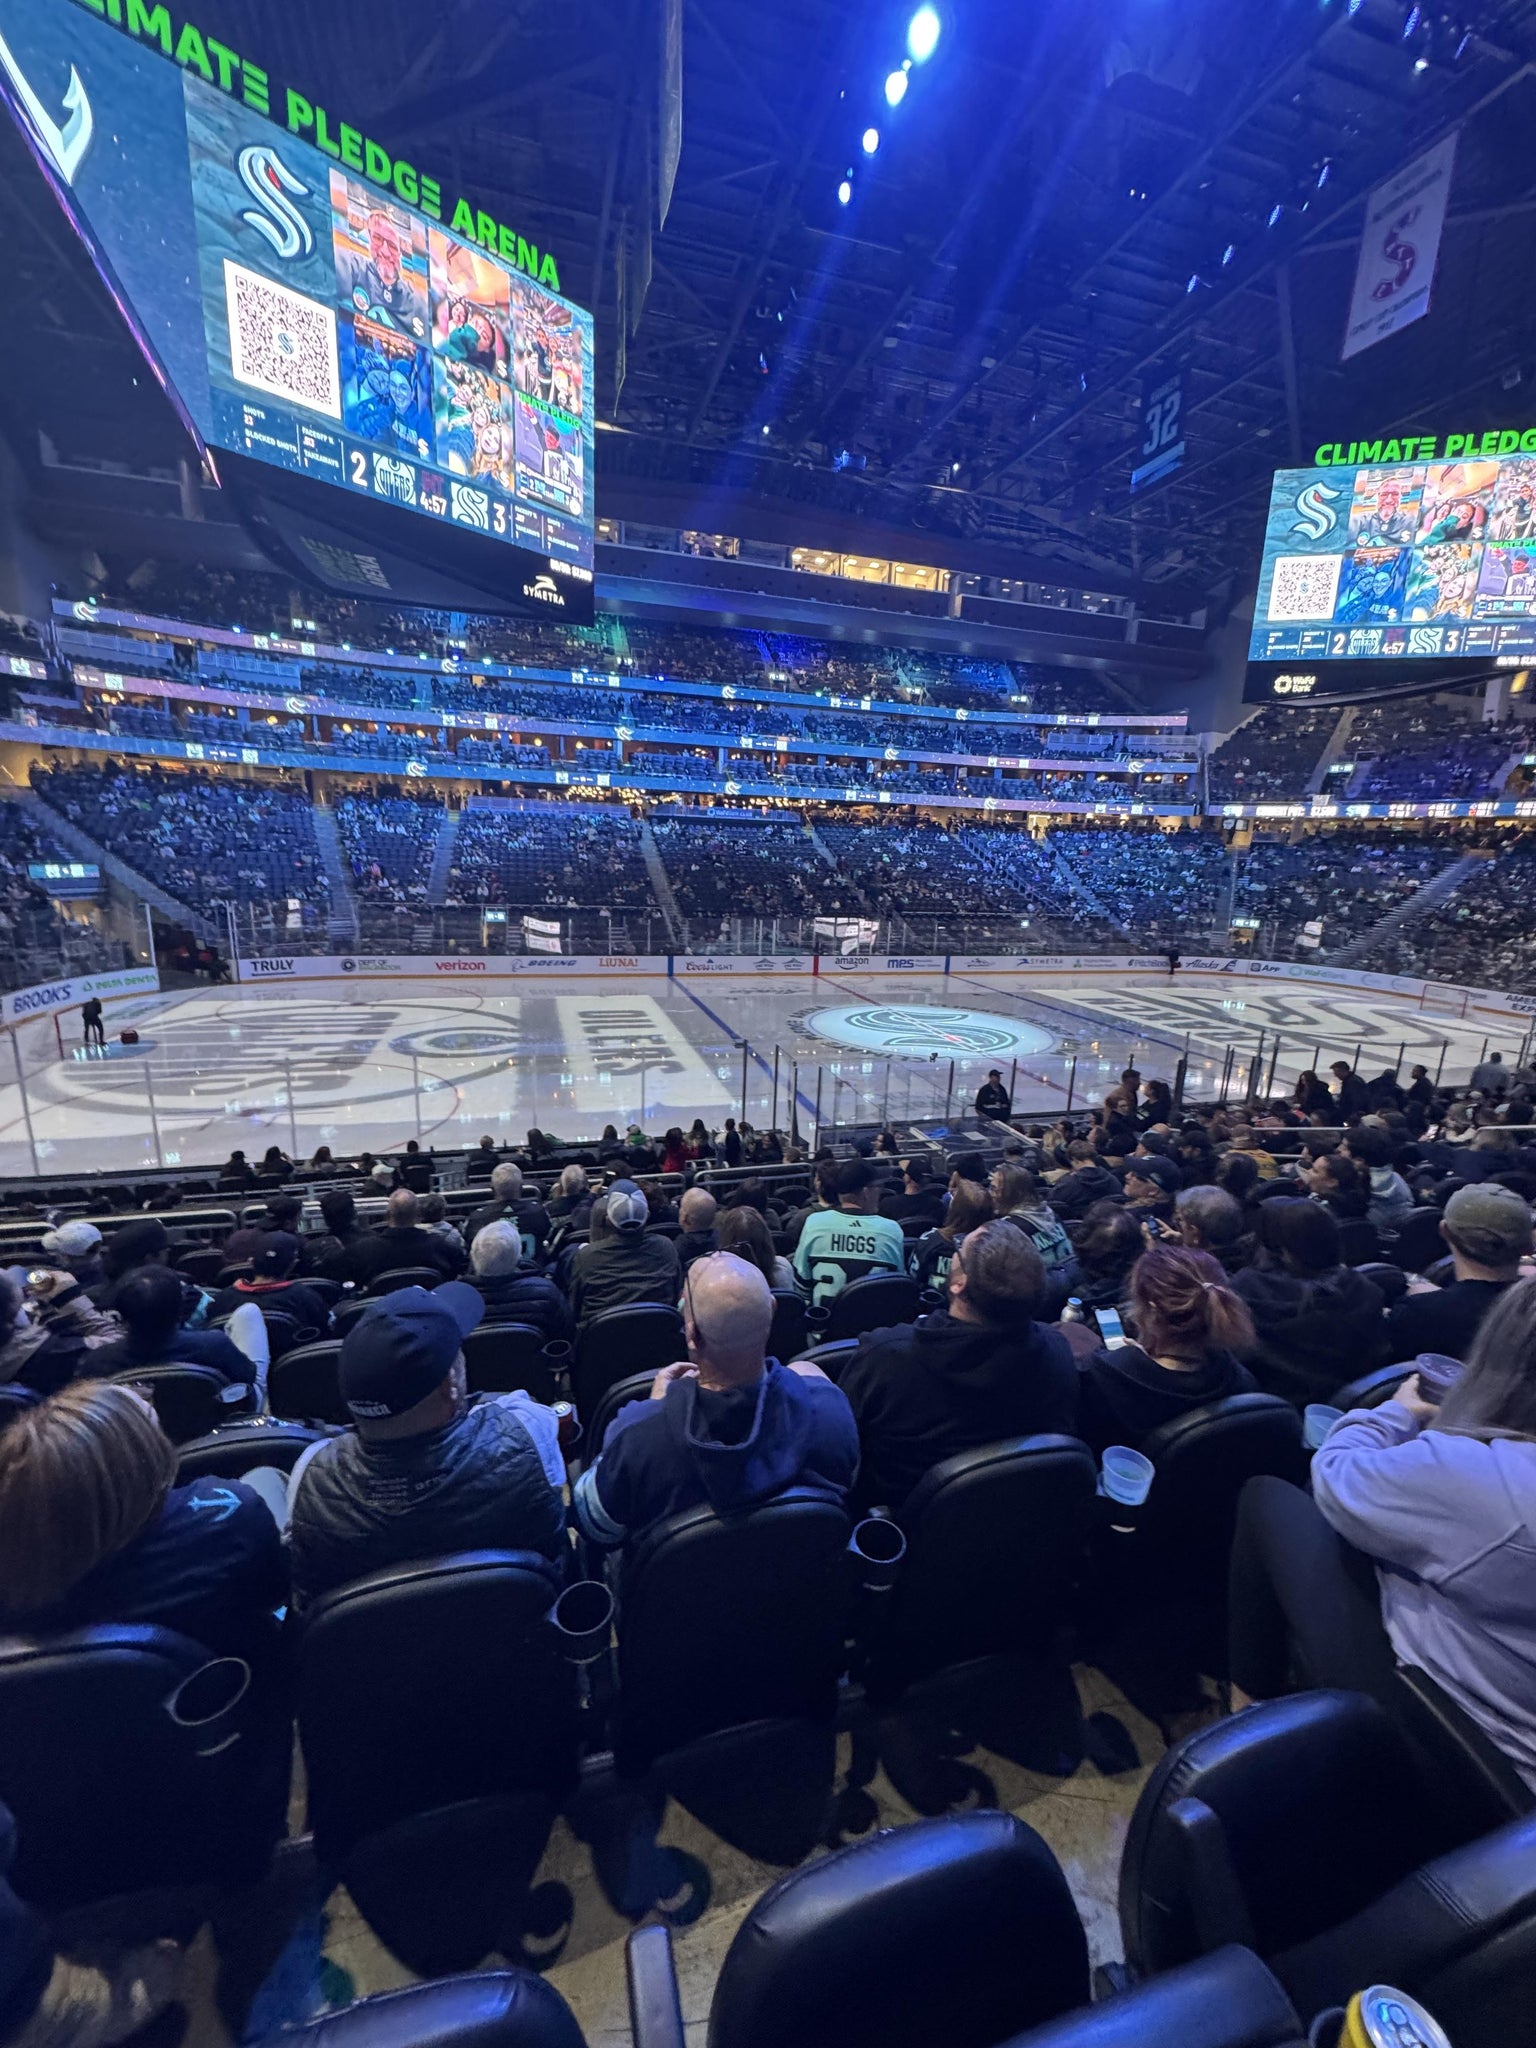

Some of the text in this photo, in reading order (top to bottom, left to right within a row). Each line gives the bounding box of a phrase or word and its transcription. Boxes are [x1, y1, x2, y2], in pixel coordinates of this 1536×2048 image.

[286, 88, 442, 219] PLEDGE
[450, 197, 560, 293] ARENA
[1143, 390, 1181, 455] 32
[1314, 436, 1437, 467] CLIMATE
[350, 451, 368, 487] 2
[379, 468, 411, 501] OILERS
[420, 492, 448, 516] 4:57
[493, 503, 506, 534] 3
[523, 584, 565, 606] SYMETRA
[1332, 634, 1346, 654] 2
[1381, 642, 1405, 655] 4:57
[1445, 631, 1459, 653] 3
[250, 960, 294, 972] TRULY
[436, 960, 486, 971] verizon
[528, 959, 577, 967] BOEING
[835, 957, 869, 966] amazon
[1186, 959, 1219, 970] Alaska
[13, 984, 72, 1014] BROOKS
[577, 1010, 687, 1076] OILERS
[831, 1233, 876, 1254] HIGGS
